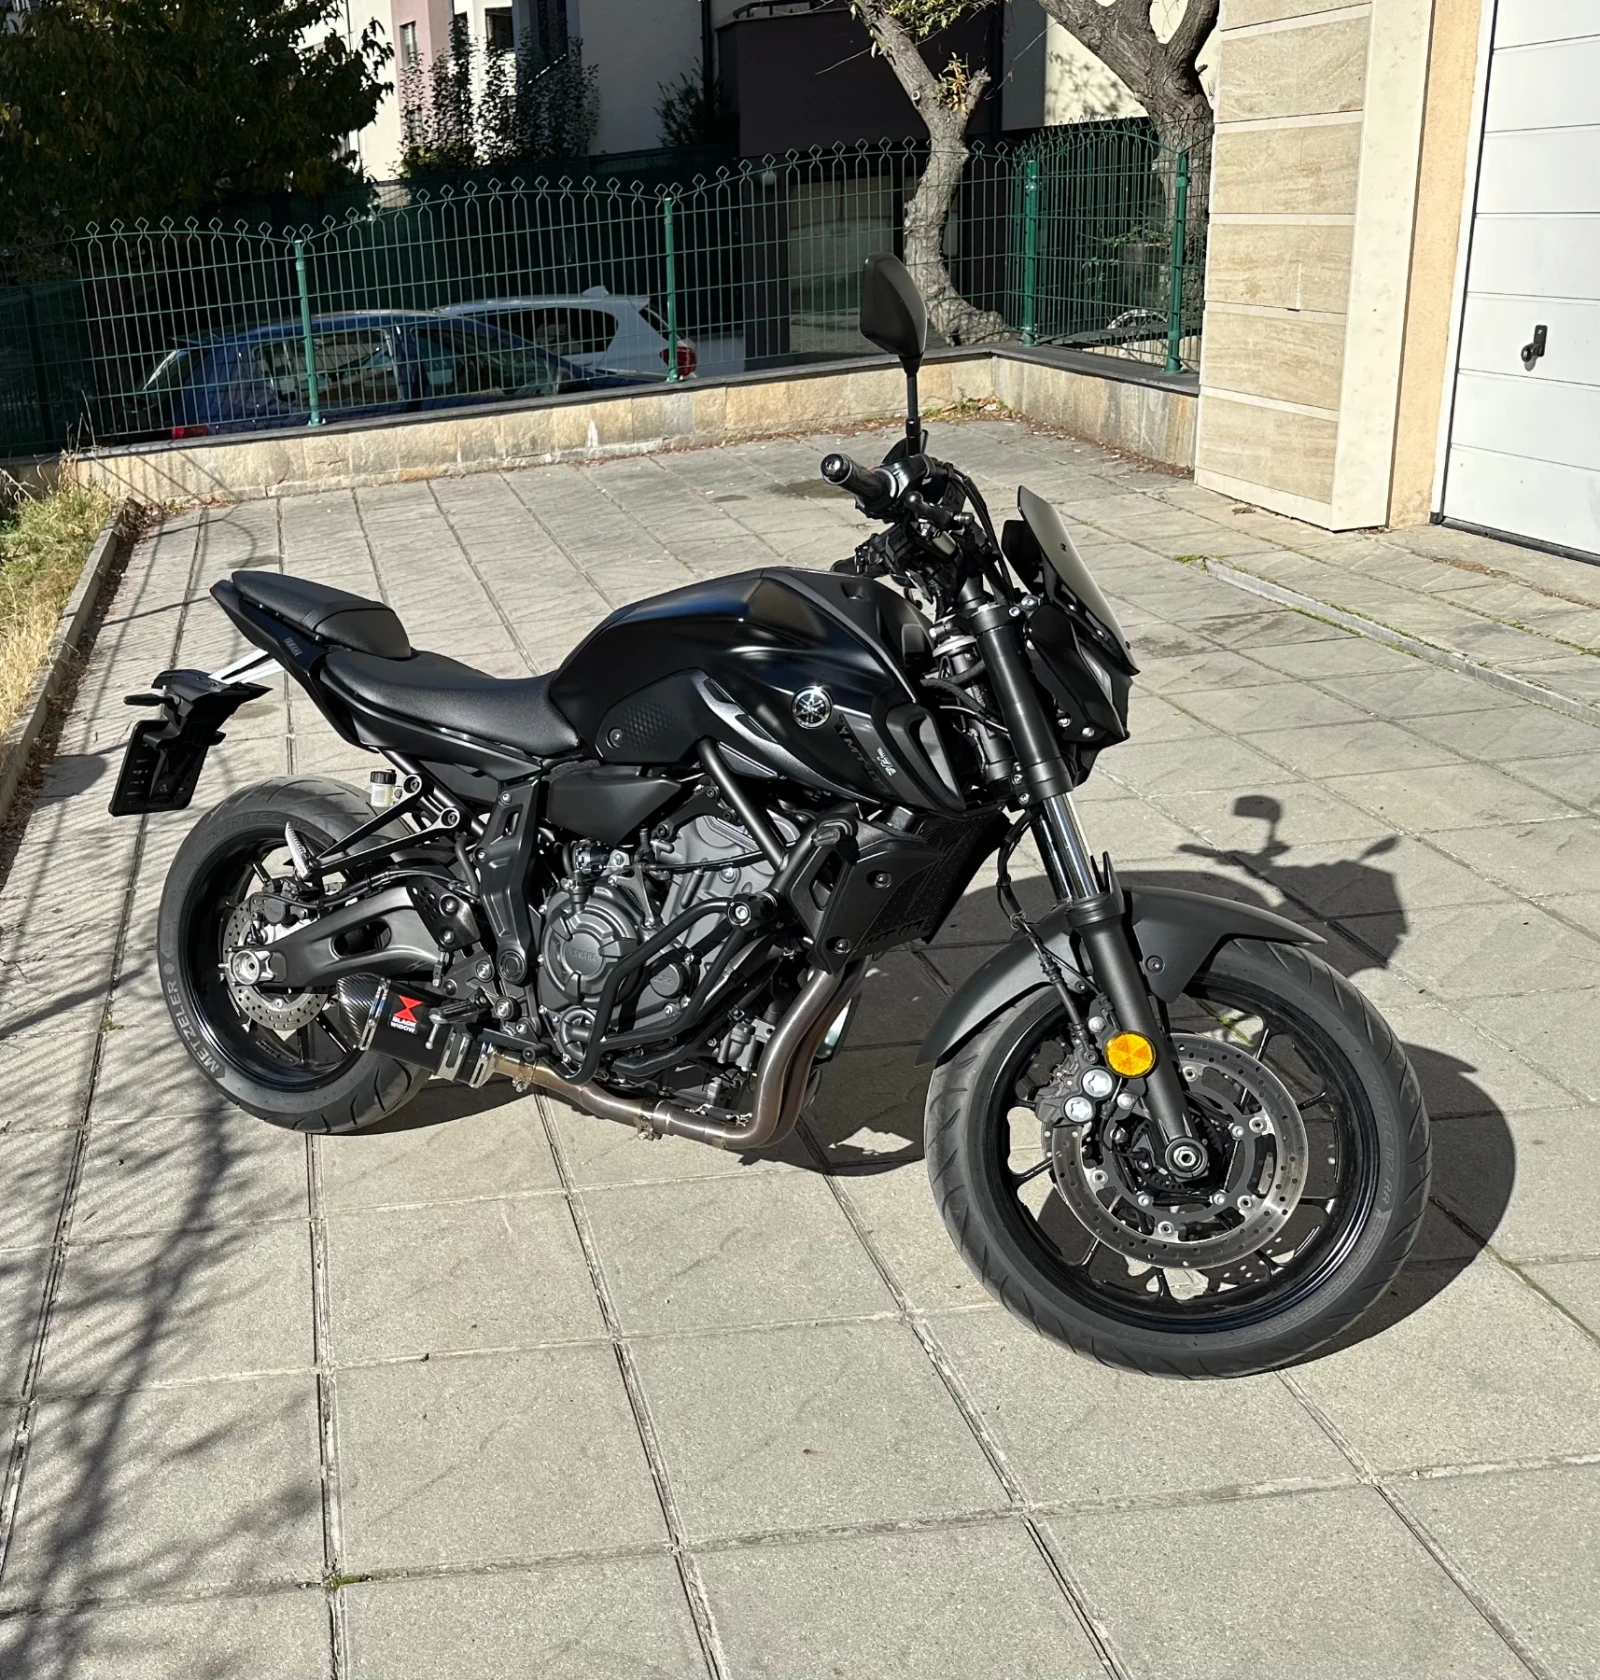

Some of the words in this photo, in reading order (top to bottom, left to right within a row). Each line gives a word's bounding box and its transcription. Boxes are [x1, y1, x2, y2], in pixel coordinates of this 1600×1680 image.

[167, 980, 220, 1074] METZELER
[390, 1021, 416, 1034] WIDOW
[392, 1016, 417, 1028] BLACK
[1382, 1177, 1393, 1205] RR
